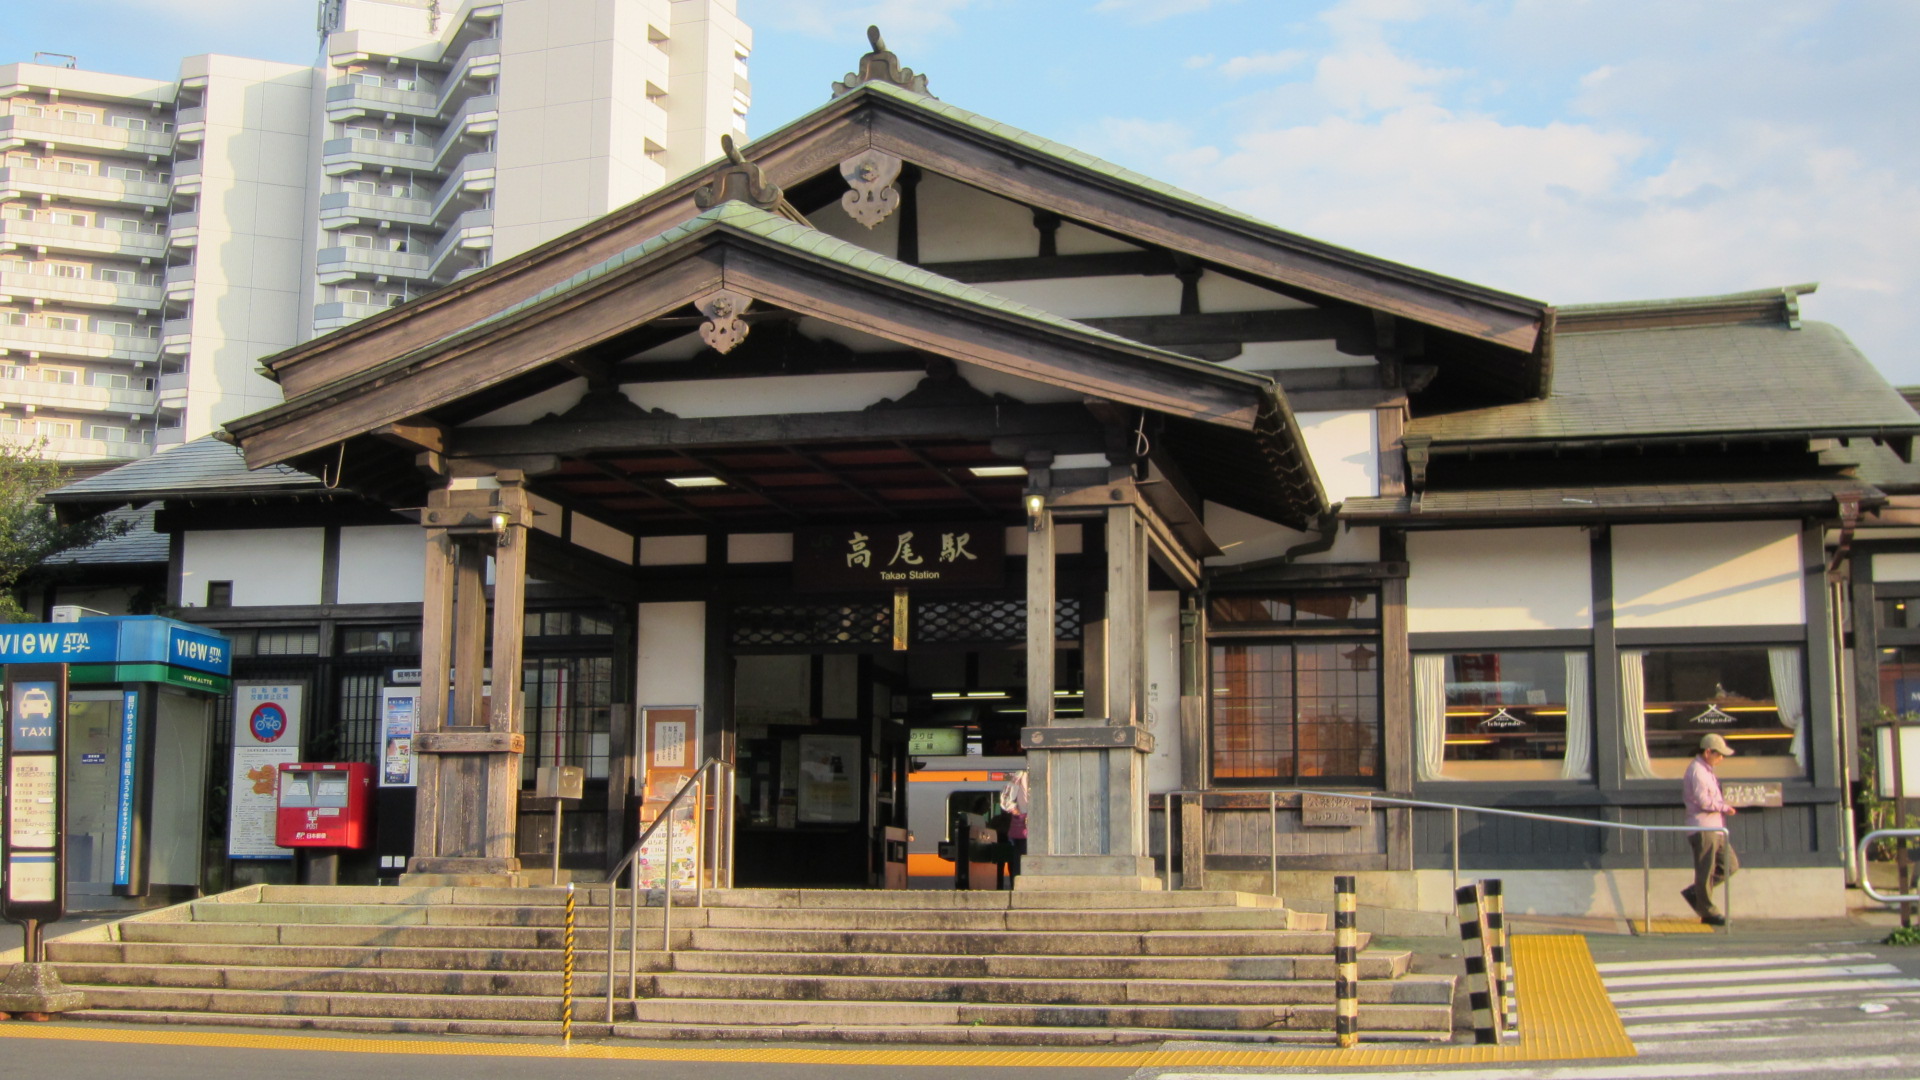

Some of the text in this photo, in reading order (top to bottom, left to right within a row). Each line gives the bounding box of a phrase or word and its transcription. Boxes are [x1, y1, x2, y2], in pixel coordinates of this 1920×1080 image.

[846, 530, 978, 568] 高尾駅
[880, 570, 940, 580] Takao Station
[63, 632, 89, 645] ATM
[62, 643, 91, 654] コーナー
[208, 645, 222, 658] ATM
[20, 726, 52, 737] TAXI
